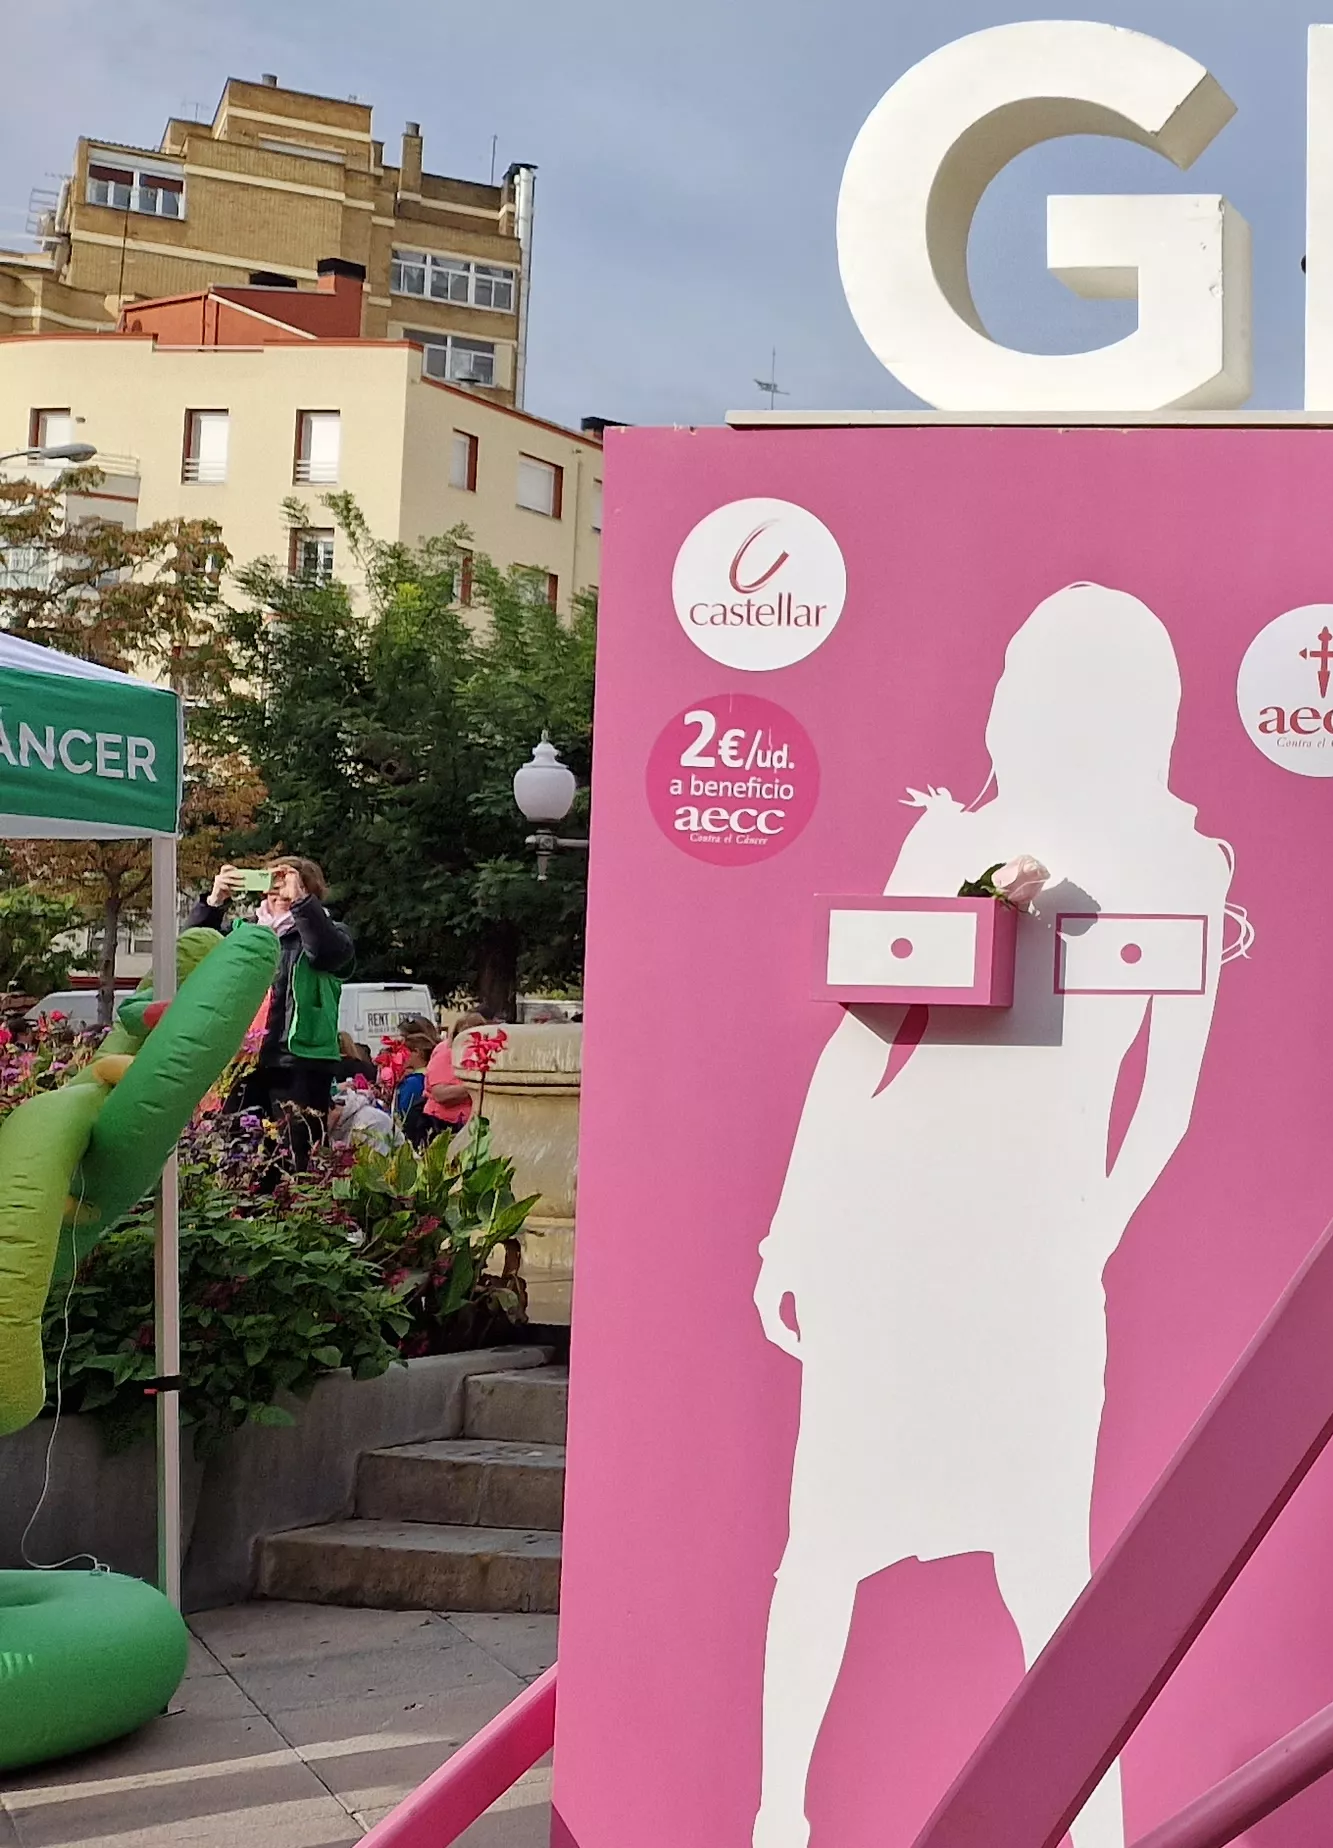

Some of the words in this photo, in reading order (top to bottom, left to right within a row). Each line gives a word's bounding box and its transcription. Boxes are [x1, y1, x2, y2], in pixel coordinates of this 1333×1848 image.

[689, 592, 827, 627] castellar
[1276, 737, 1312, 748] Contra
[1317, 737, 1326, 748] el
[669, 779, 682, 795] a
[690, 773, 794, 800] beneficio
[674, 805, 785, 834] aecc
[724, 834, 732, 843] el
[368, 1012, 388, 1026] RENT
